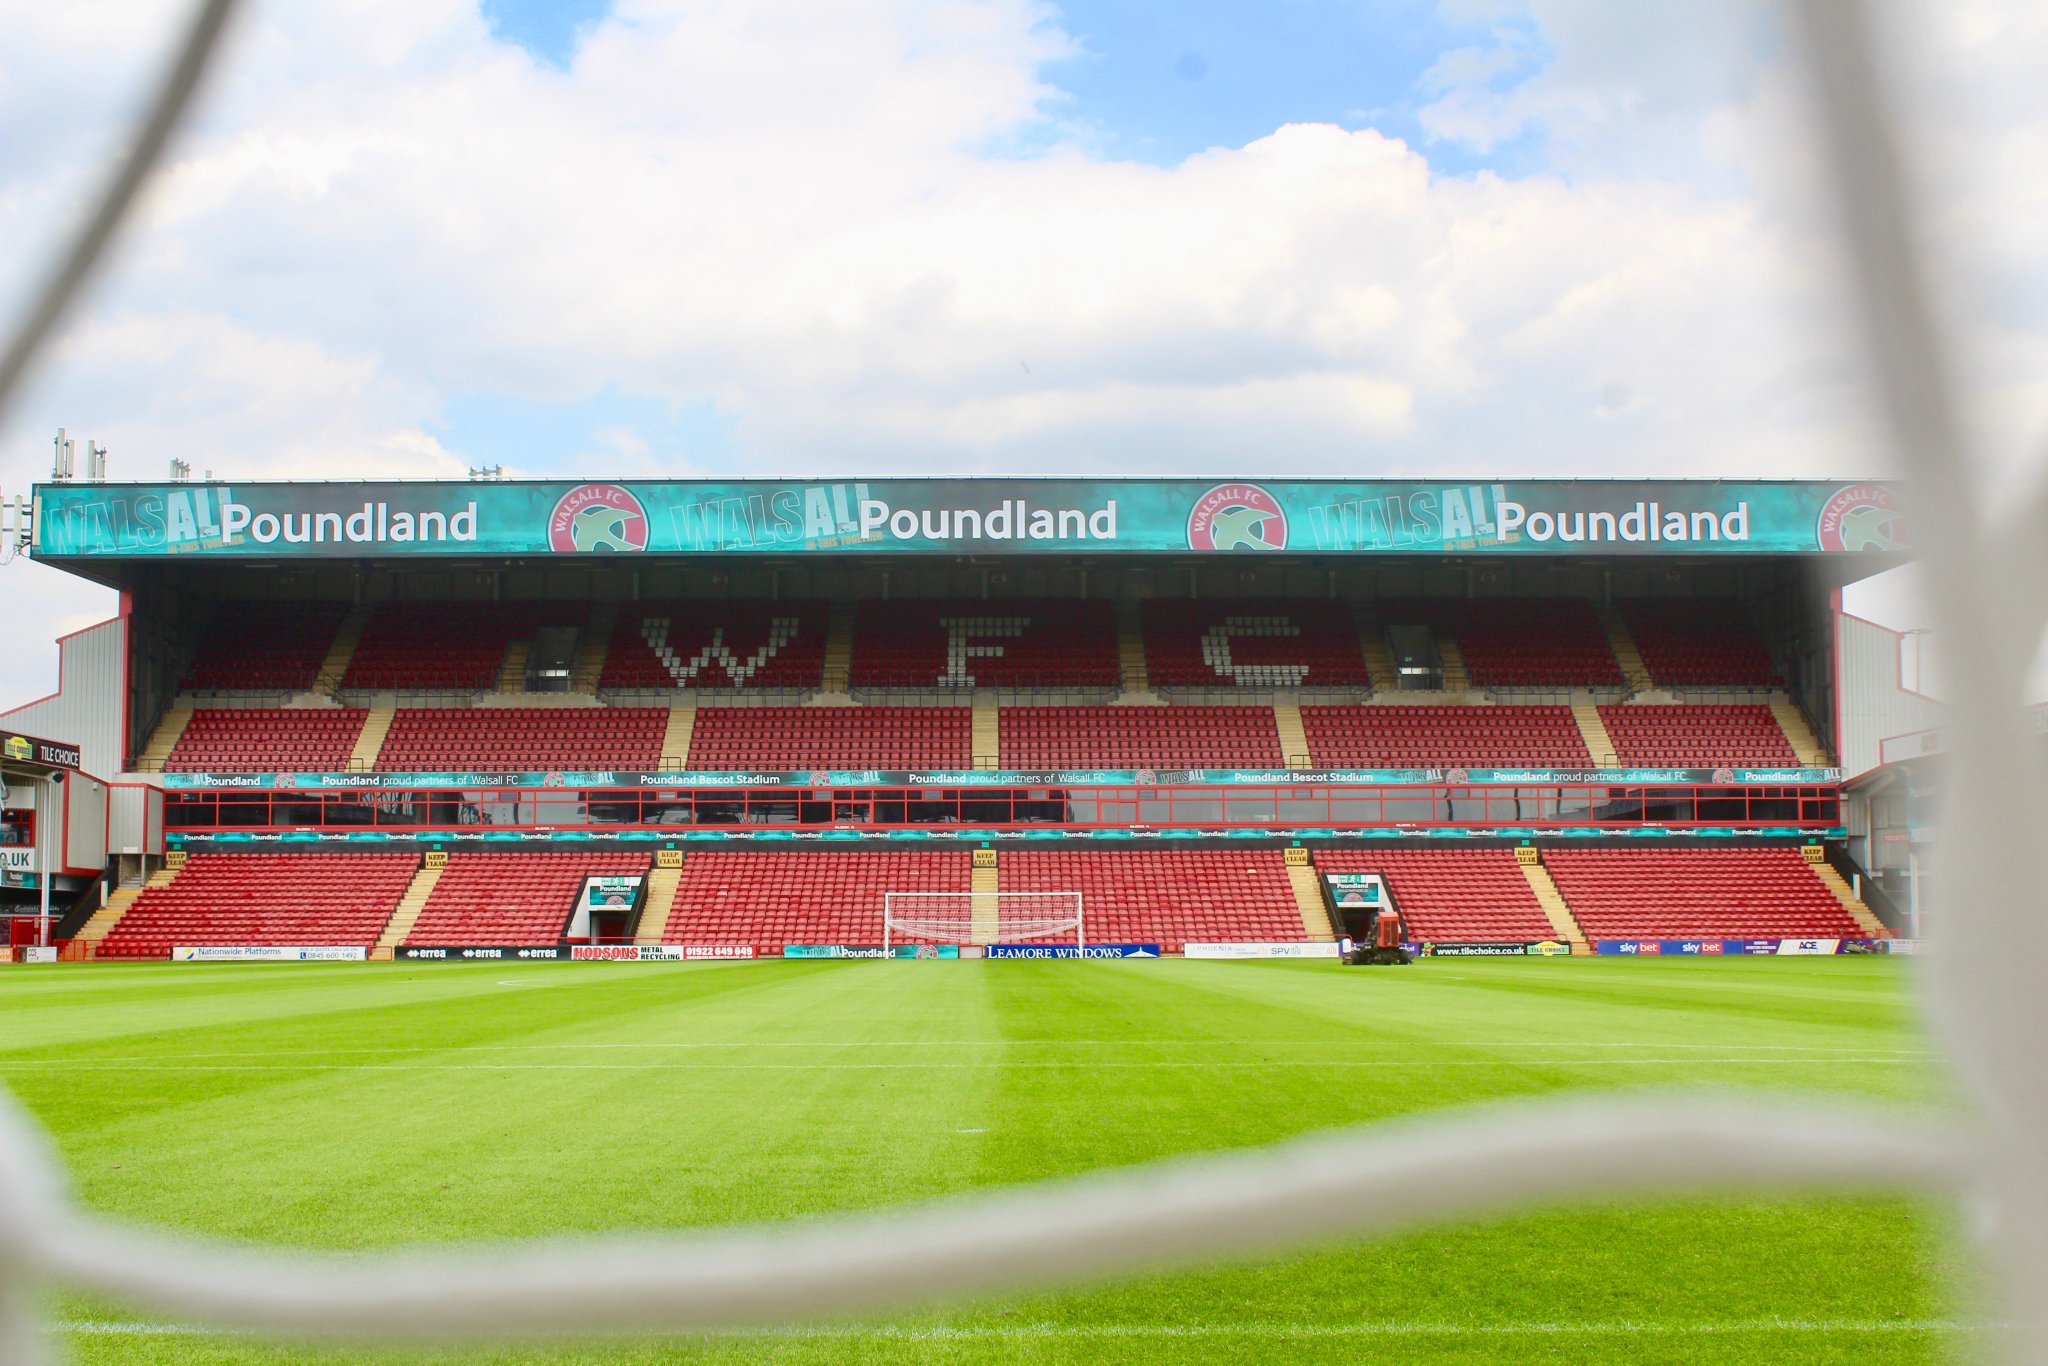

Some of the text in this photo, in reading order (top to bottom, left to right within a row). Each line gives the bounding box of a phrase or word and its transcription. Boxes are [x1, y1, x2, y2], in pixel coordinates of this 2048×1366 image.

[556, 488, 622, 533] WALSALL FC
[1194, 488, 1261, 533] WALSALL FC
[221, 502, 477, 543] Poundland
[860, 500, 1116, 540] Poundland
[1497, 502, 1748, 542] Poundland
[40, 745, 79, 767] TILE CHOICE
[205, 776, 260, 786] Poundland
[322, 776, 518, 788] Poundland proud partners of Walsall FC
[641, 775, 780, 784] Poundland Bescot Stadium
[909, 773, 1105, 785] Poundland proud partners of Walsall FC
[1160, 770, 1205, 784] WALSALL
[1234, 772, 1373, 782] Poundland Bescot Stadium
[1493, 772, 1687, 783] Poundland proud partners of Walsall FC
[1745, 772, 1800, 781] Poundland
[574, 947, 638, 960] HODSONS
[686, 947, 753, 955] 01922 649 649
[1437, 946, 1524, 955] www.tilechoice.co.uk
[1620, 942, 1657, 953] sky bet
[1682, 942, 1719, 953] sky bet
